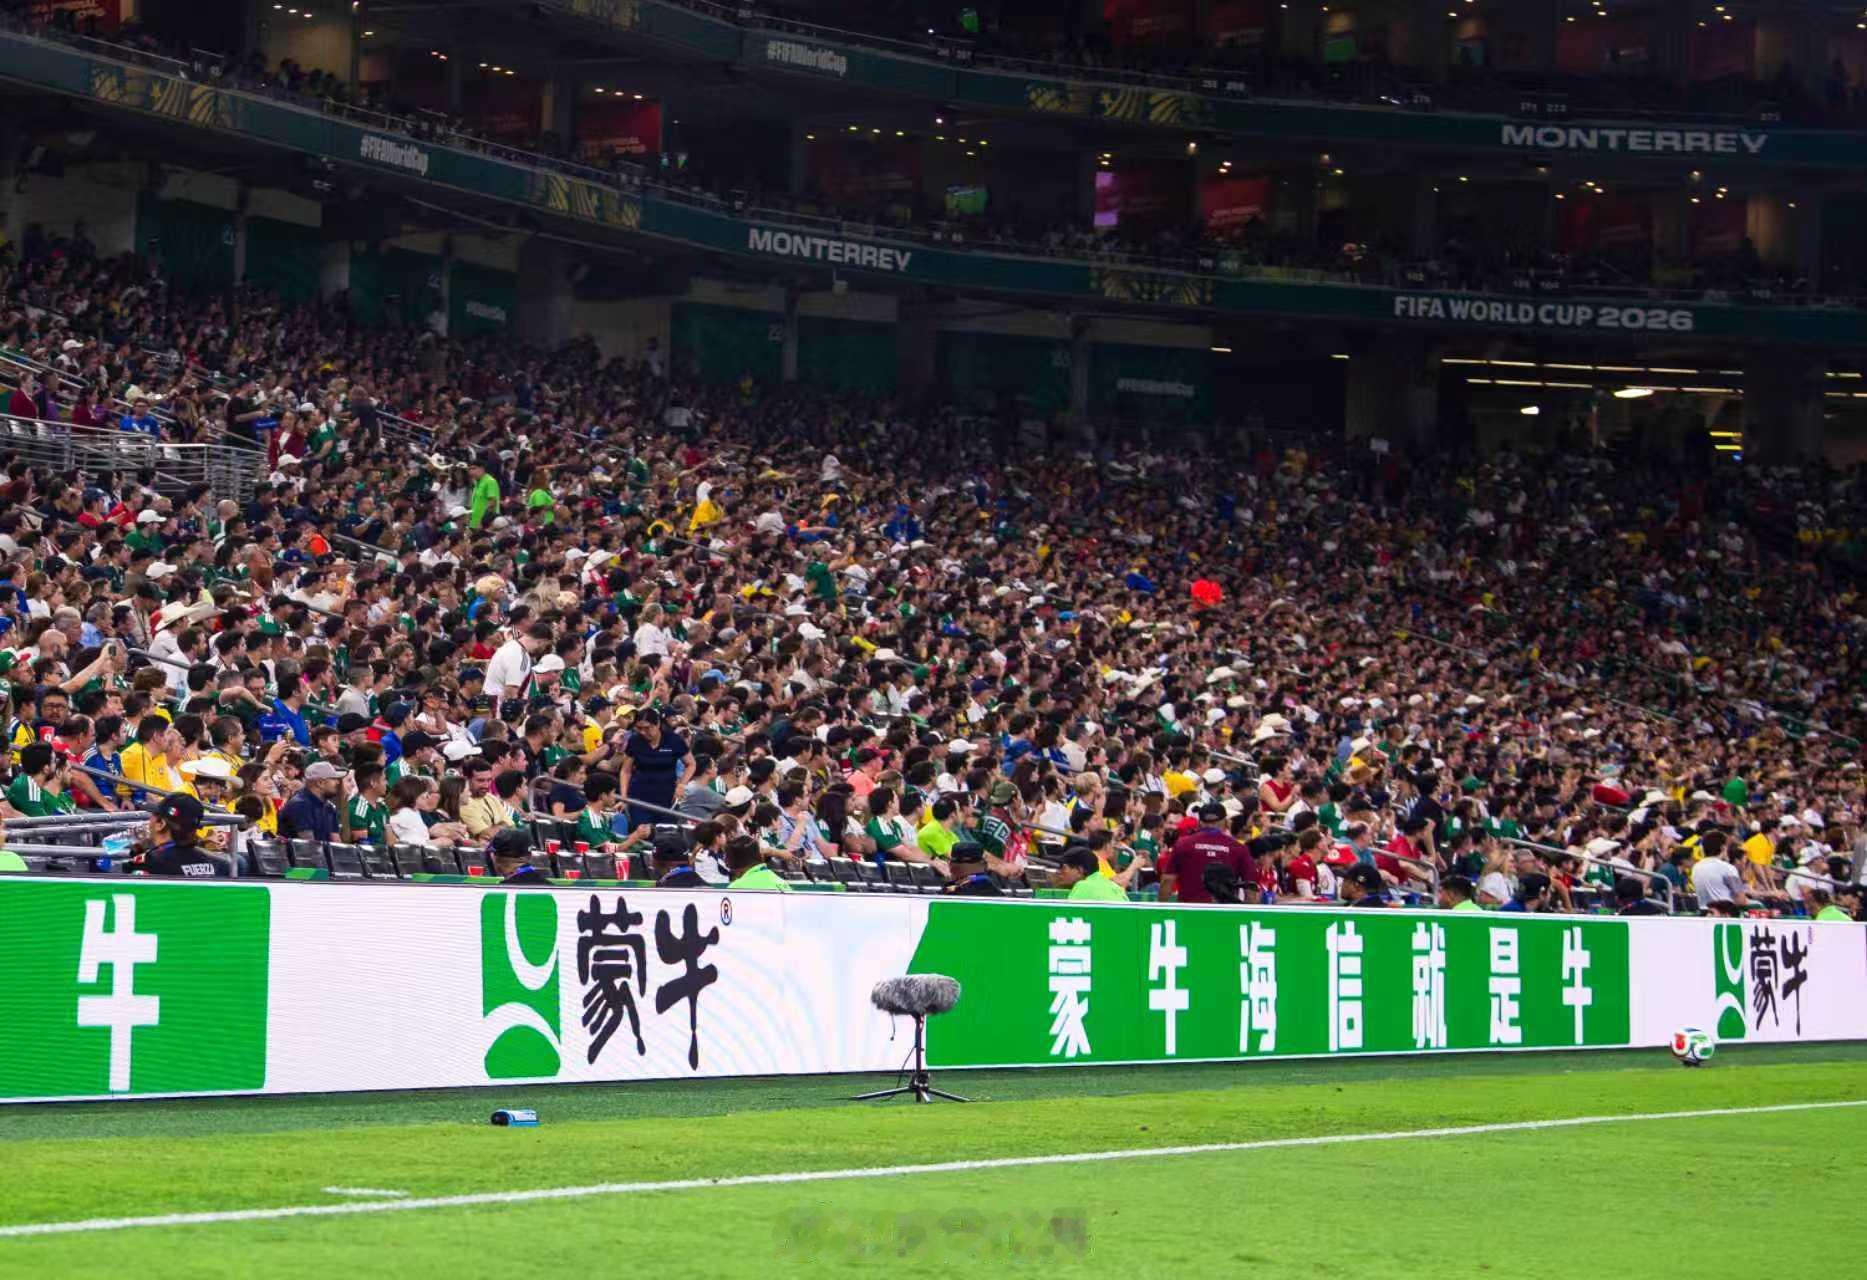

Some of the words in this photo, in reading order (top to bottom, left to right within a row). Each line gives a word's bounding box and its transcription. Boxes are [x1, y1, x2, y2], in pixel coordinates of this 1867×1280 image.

[1501, 124, 1768, 154] MONTERREY
[748, 227, 913, 273] MONTERREY
[1394, 295, 1446, 319] FIFA
[1449, 298, 1534, 324] WORLD
[1538, 303, 1594, 326] CUP
[1597, 306, 1695, 331] 2026
[77, 893, 160, 1092] 牛
[577, 894, 720, 1070] 蒙牛
[1048, 916, 1593, 1058] 蒙牛海信就是牛
[1750, 924, 1808, 1036] 蒙牛
